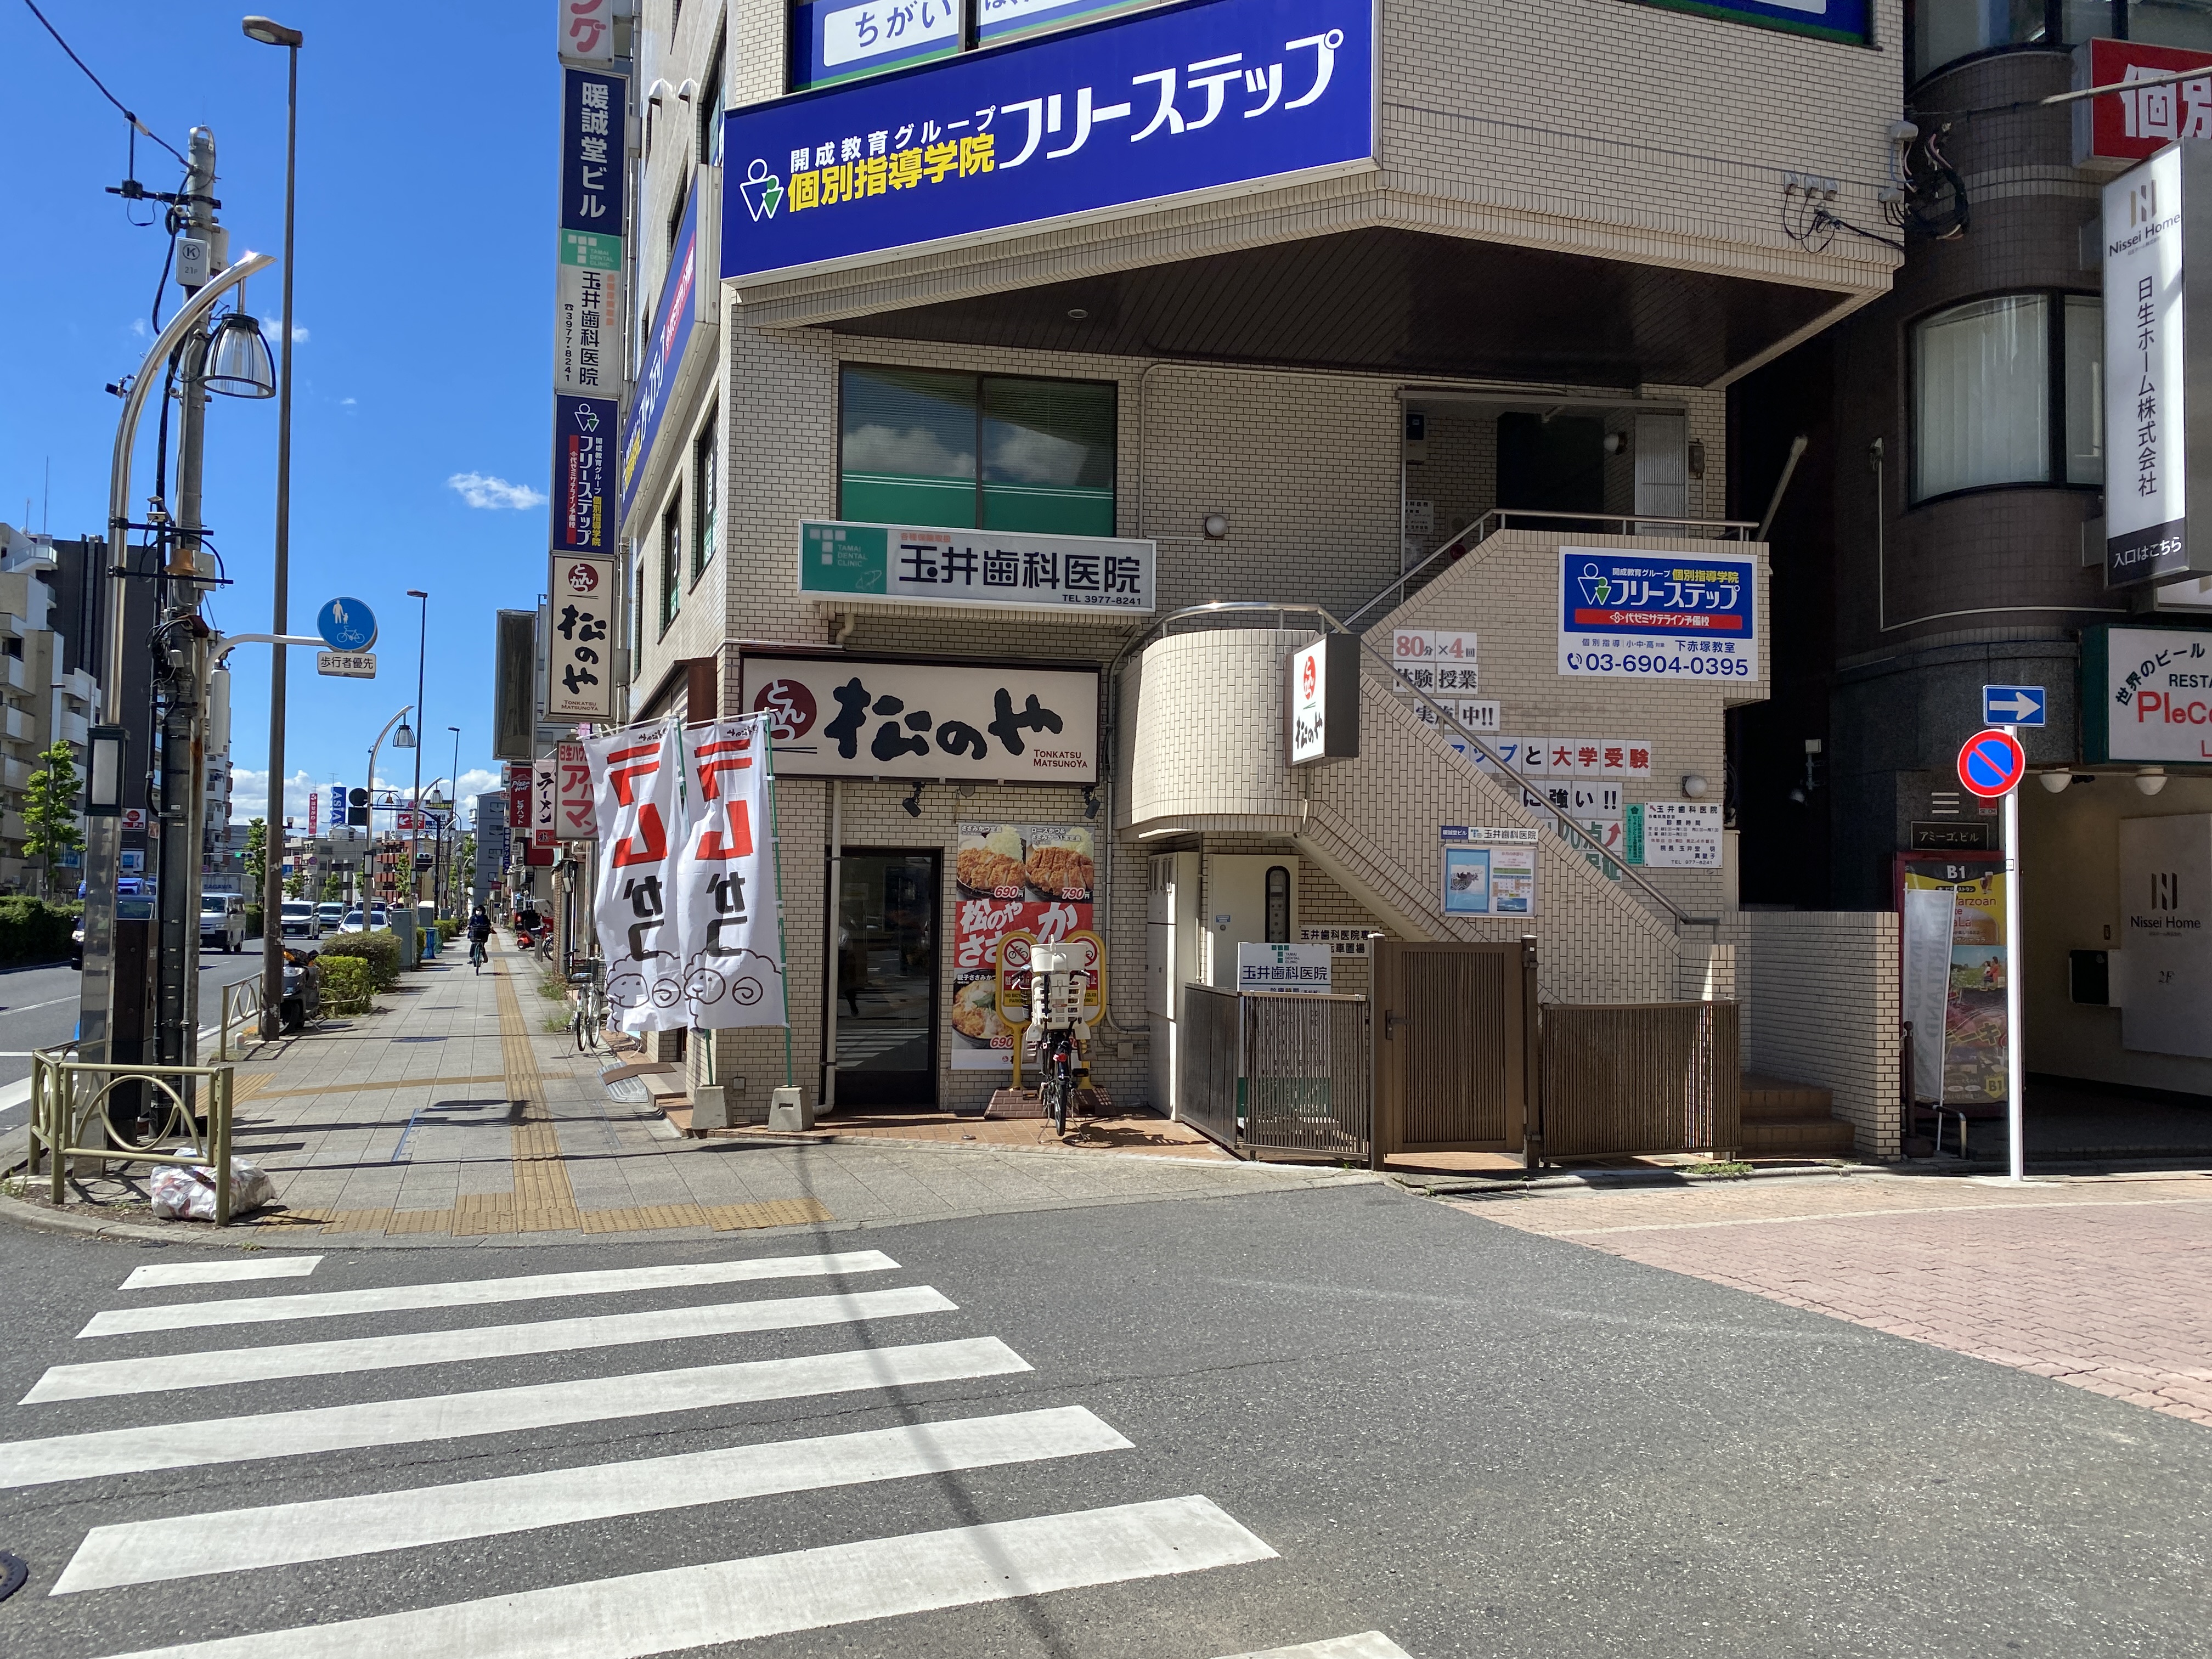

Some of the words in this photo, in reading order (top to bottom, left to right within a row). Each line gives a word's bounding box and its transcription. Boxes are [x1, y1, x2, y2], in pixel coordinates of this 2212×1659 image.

[998, 28, 1345, 170] フリーステップ
[791, 104, 997, 174] 開成教育グループ
[579, 82, 610, 218] 暖誠堂ビル
[787, 133, 995, 213] 個別指導学院
[2109, 230, 2141, 257] Nissei
[2145, 214, 2181, 239] Home
[579, 270, 601, 386] 玉井歯科医院
[2137, 275, 2157, 497] 日生ホーム株式会社
[577, 436, 592, 545] フリーステップ
[837, 544, 862, 552] TAMAI
[837, 552, 868, 561] DENTAL
[2113, 535, 2182, 568] 入口はこちら
[837, 559, 862, 568] CLINIC
[898, 544, 1142, 594] 玉井歯科医院
[569, 563, 594, 594] とんかつ
[1612, 567, 1671, 578] 開成教育グループ
[1672, 568, 1739, 583] 個別指導学院
[1062, 594, 1081, 603] TEL
[1084, 595, 1142, 606] 3977-8241
[1611, 579, 1740, 610] フリーステップ
[1625, 612, 1710, 627] 代ゼミサテライン予備校
[557, 604, 607, 695] 松のや
[1582, 638, 1621, 647] 個別指導
[1674, 640, 1736, 653] 下赤塚教室
[320, 656, 374, 669] 歩行者優先
[1585, 653, 1749, 676] 03-6904-0395
[2115, 642, 2205, 706] 世界のビール
[824, 676, 1064, 761] 松のや
[1295, 711, 1323, 749] 松のや
[560, 745, 587, 762] 日生ハウ
[511, 780, 531, 788] Pizza
[515, 785, 528, 793] Hut
[537, 772, 555, 824] ラーメン
[1656, 805, 1718, 814] 玉井歯科医院
[961, 825, 1003, 833] ささみかつ定食
[1483, 829, 1537, 840] 玉井歯科医院
[1946, 865, 1966, 879] B1
[1955, 895, 1996, 906] arzoan
[959, 898, 1024, 934] 松のや
[2130, 915, 2162, 928] Nissei
[2166, 915, 2202, 928] Home
[1242, 966, 1328, 980] 玉井歯科医院
[1988, 1080, 2002, 1092] B1
